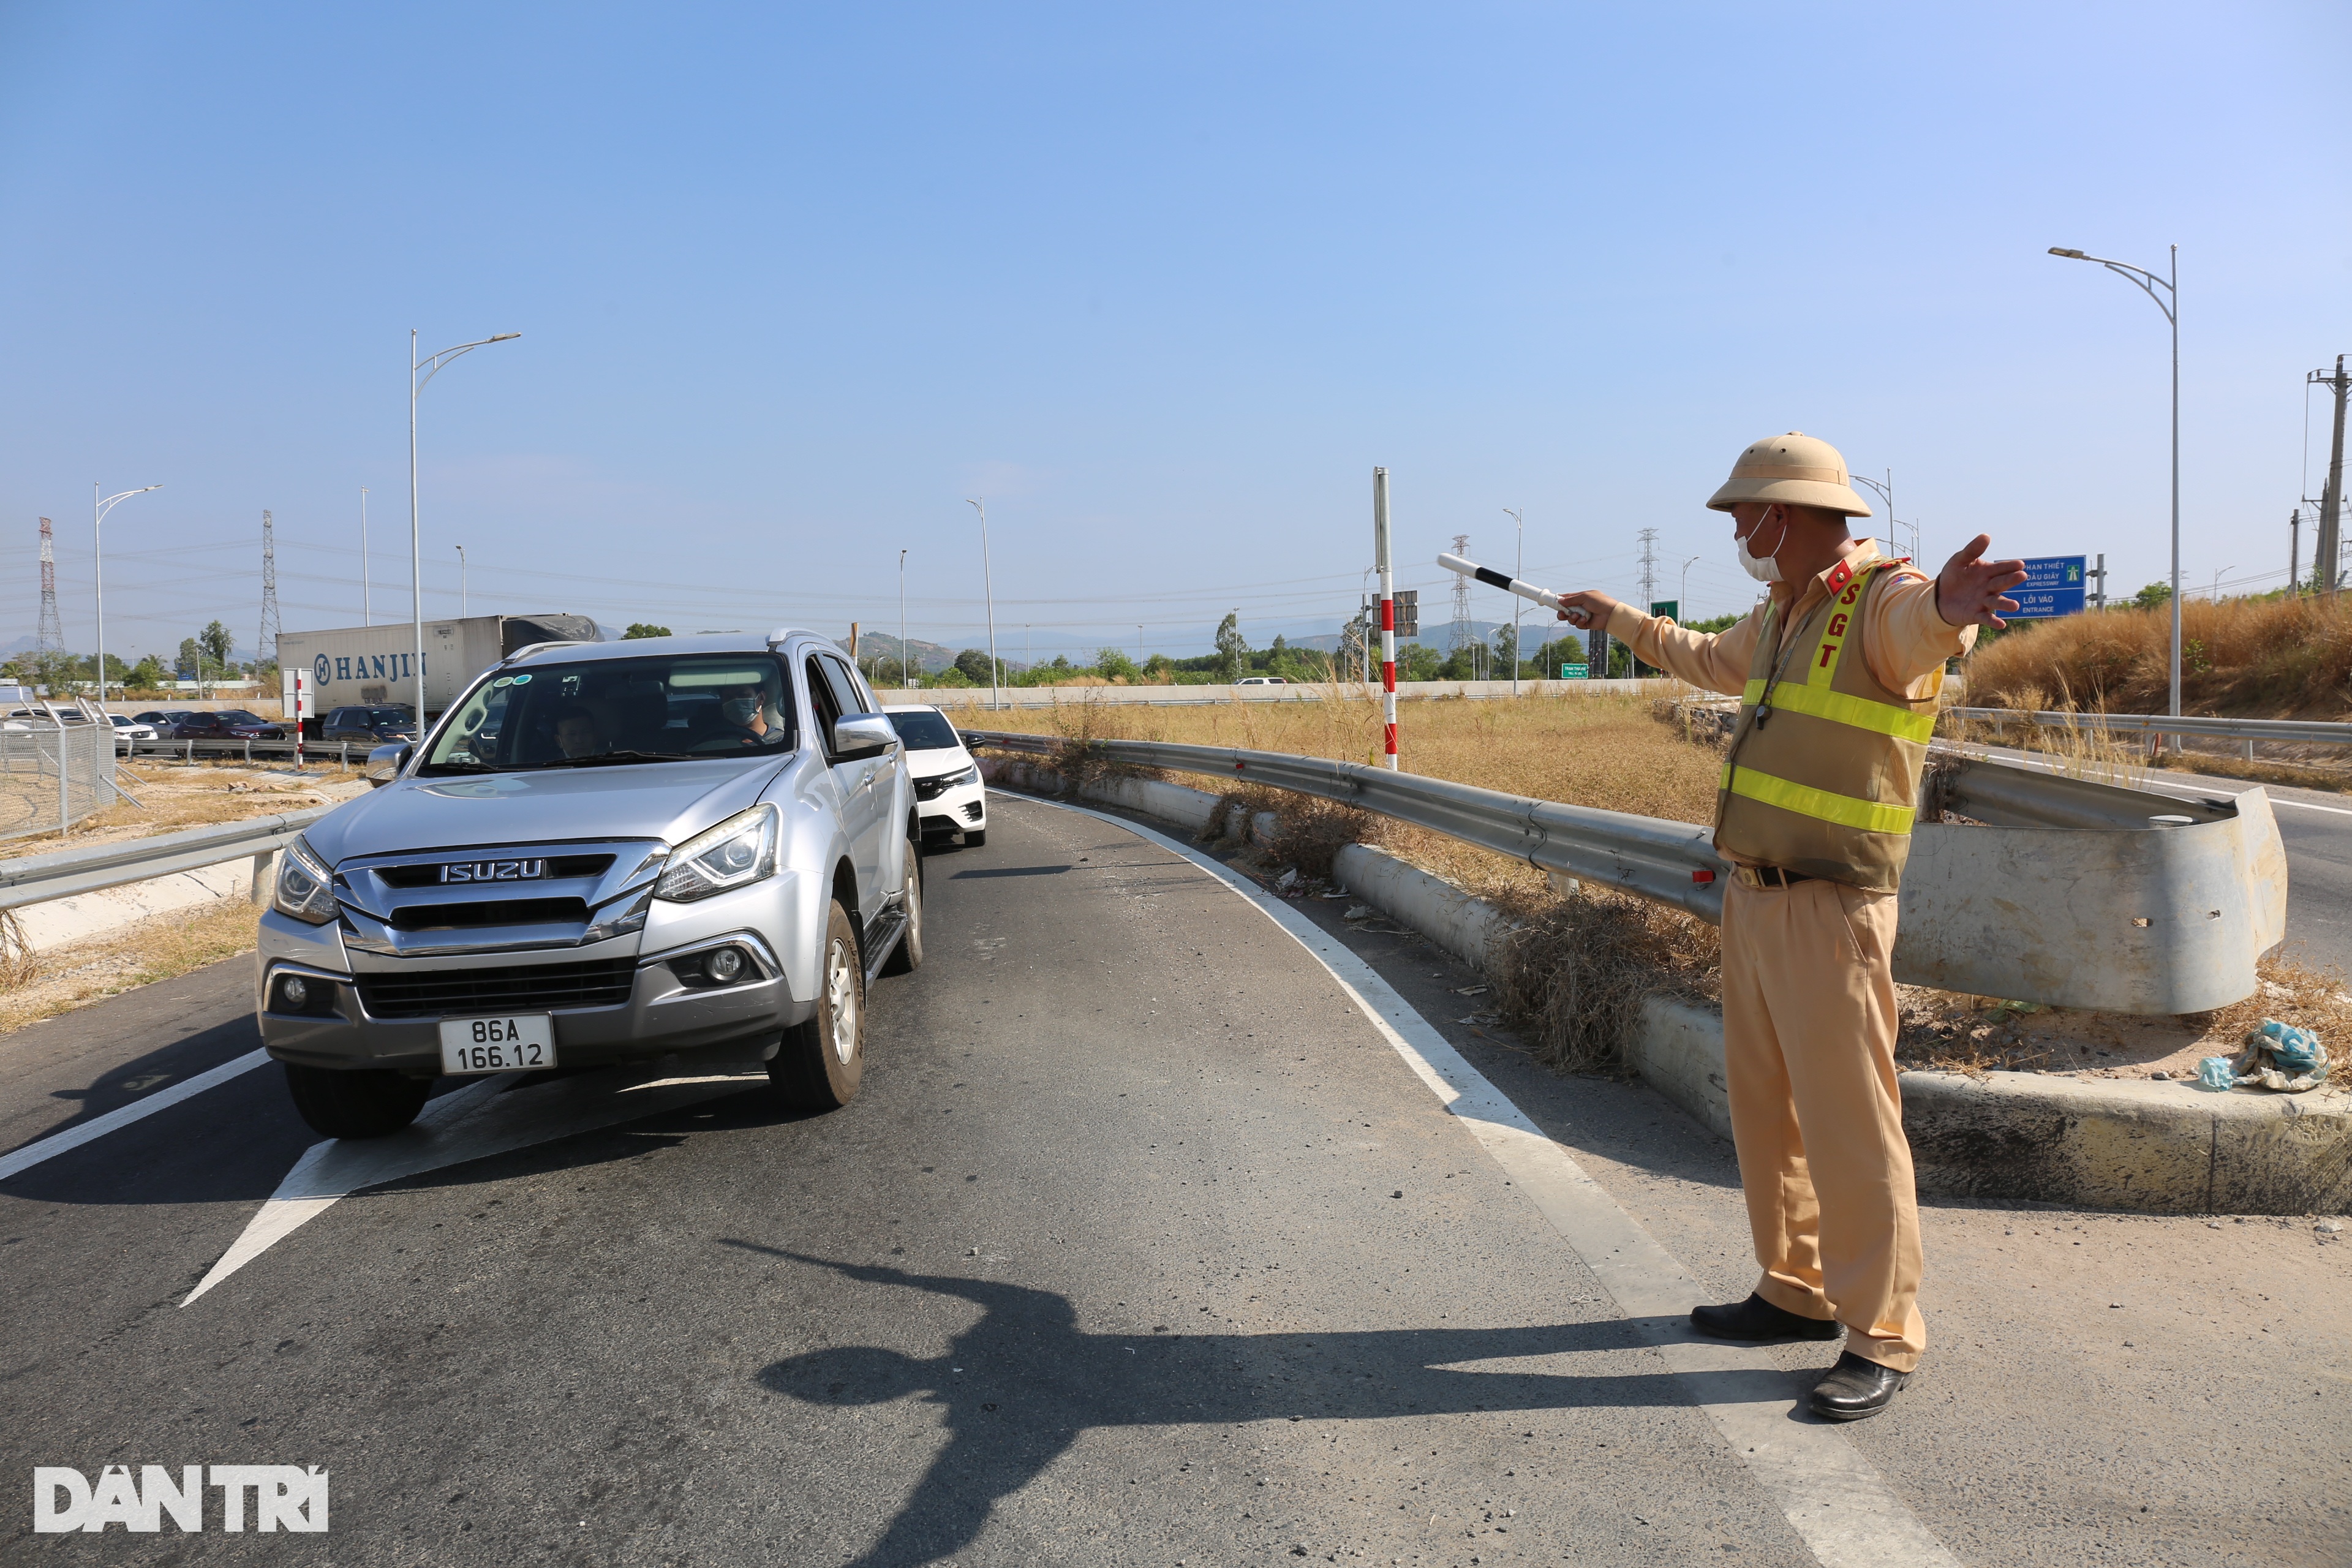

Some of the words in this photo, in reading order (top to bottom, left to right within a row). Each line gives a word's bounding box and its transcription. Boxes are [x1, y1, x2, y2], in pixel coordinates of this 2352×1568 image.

[2044, 560, 2065, 570] THIẾT
[2038, 595, 2053, 603] VÀO
[441, 860, 541, 882] ISUZU
[472, 1019, 519, 1042] 86A
[458, 1043, 543, 1069] 166.12
